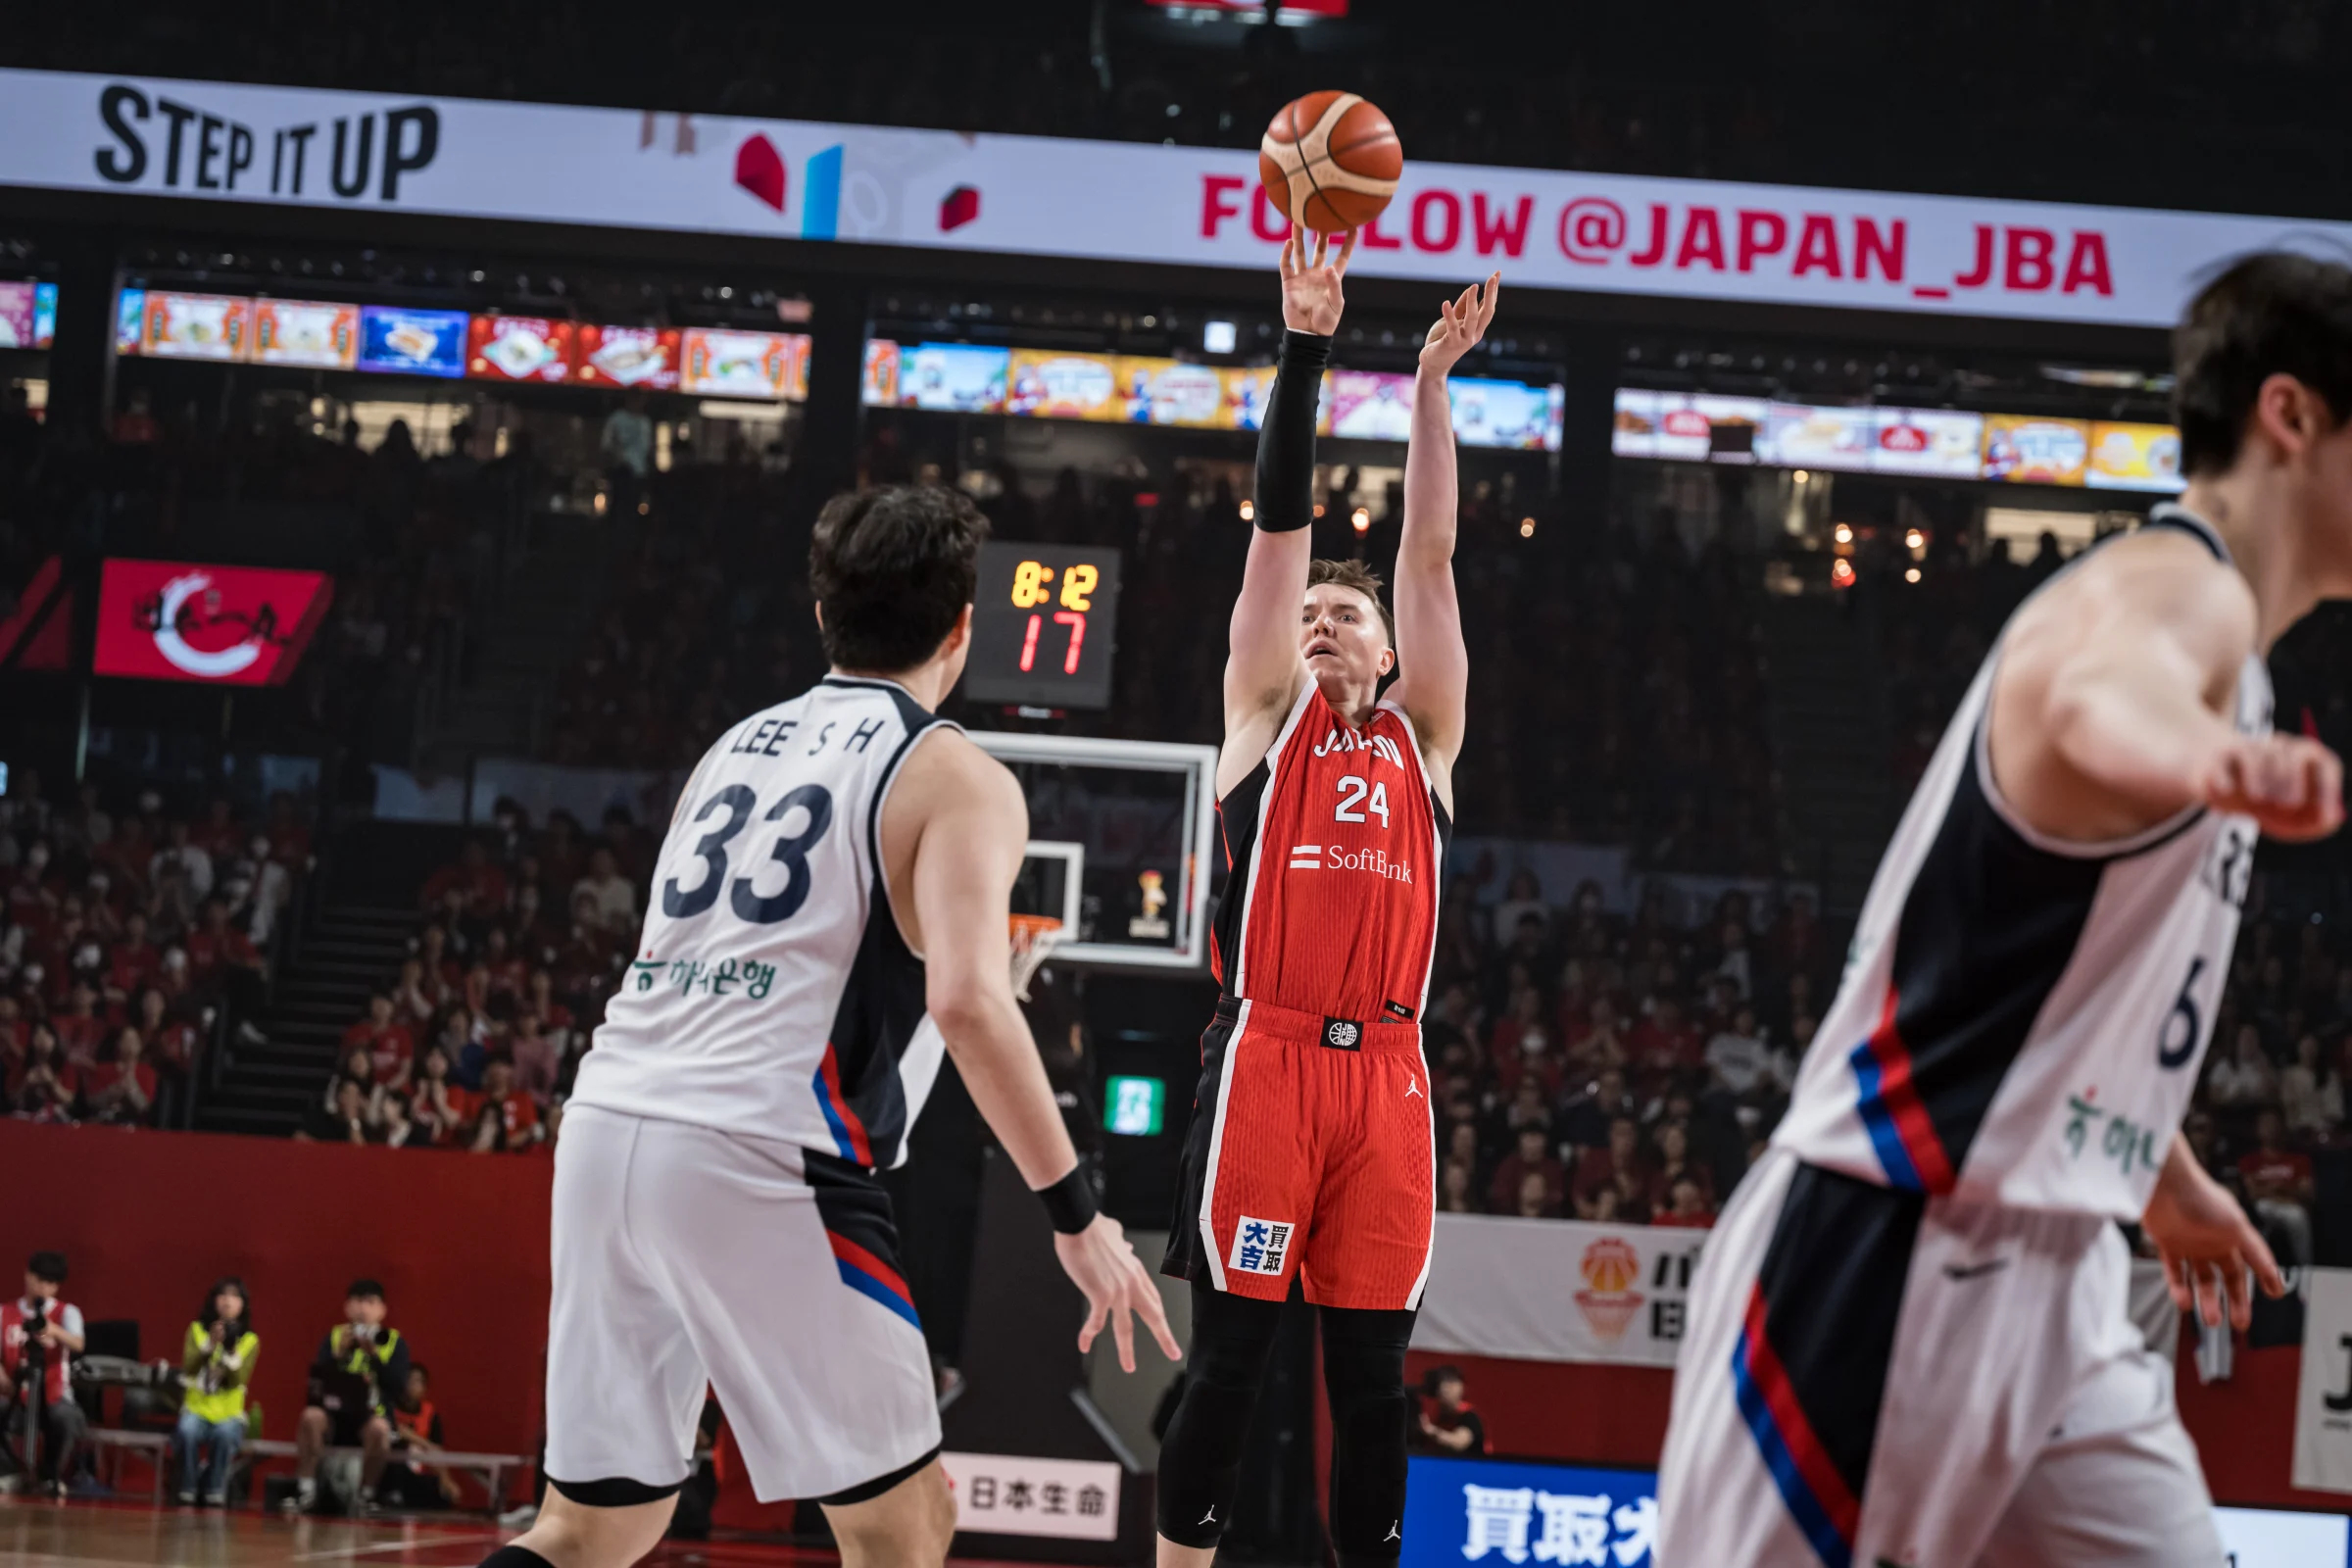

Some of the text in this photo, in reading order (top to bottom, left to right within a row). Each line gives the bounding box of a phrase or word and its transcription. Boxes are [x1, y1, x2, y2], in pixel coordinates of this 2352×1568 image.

[95, 84, 439, 202] STEP IT UP
[1558, 196, 2114, 300] @JAPAN_JBA
[1011, 561, 1099, 612] 8:12
[1019, 612, 1086, 674] 17
[730, 717, 885, 757] LEE S H
[1335, 775, 1390, 829] 24
[662, 783, 833, 924] 33
[1328, 845, 1413, 884] SoftBnk
[1239, 1222, 1269, 1270] 大吉
[1262, 1224, 1290, 1272] 買取
[969, 1475, 1106, 1516] 日本生命
